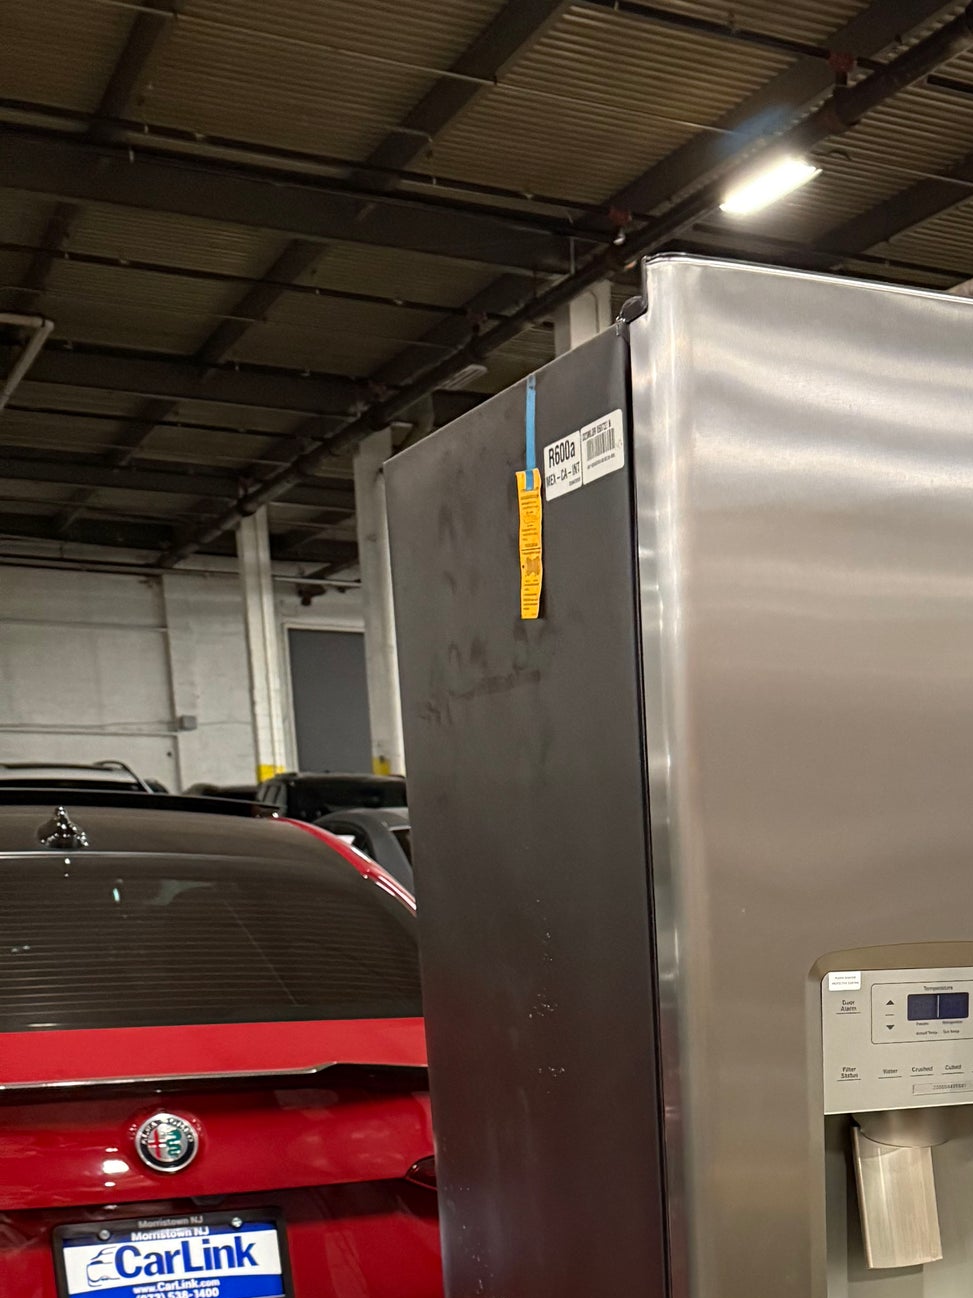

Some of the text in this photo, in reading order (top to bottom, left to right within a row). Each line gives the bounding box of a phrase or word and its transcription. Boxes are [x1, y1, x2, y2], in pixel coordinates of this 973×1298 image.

[548, 440, 576, 469] R600a
[131, 1226, 210, 1242] Morristown NJ
[114, 1235, 259, 1280] CarLink
[132, 1279, 221, 1295] www.CarLink.com
